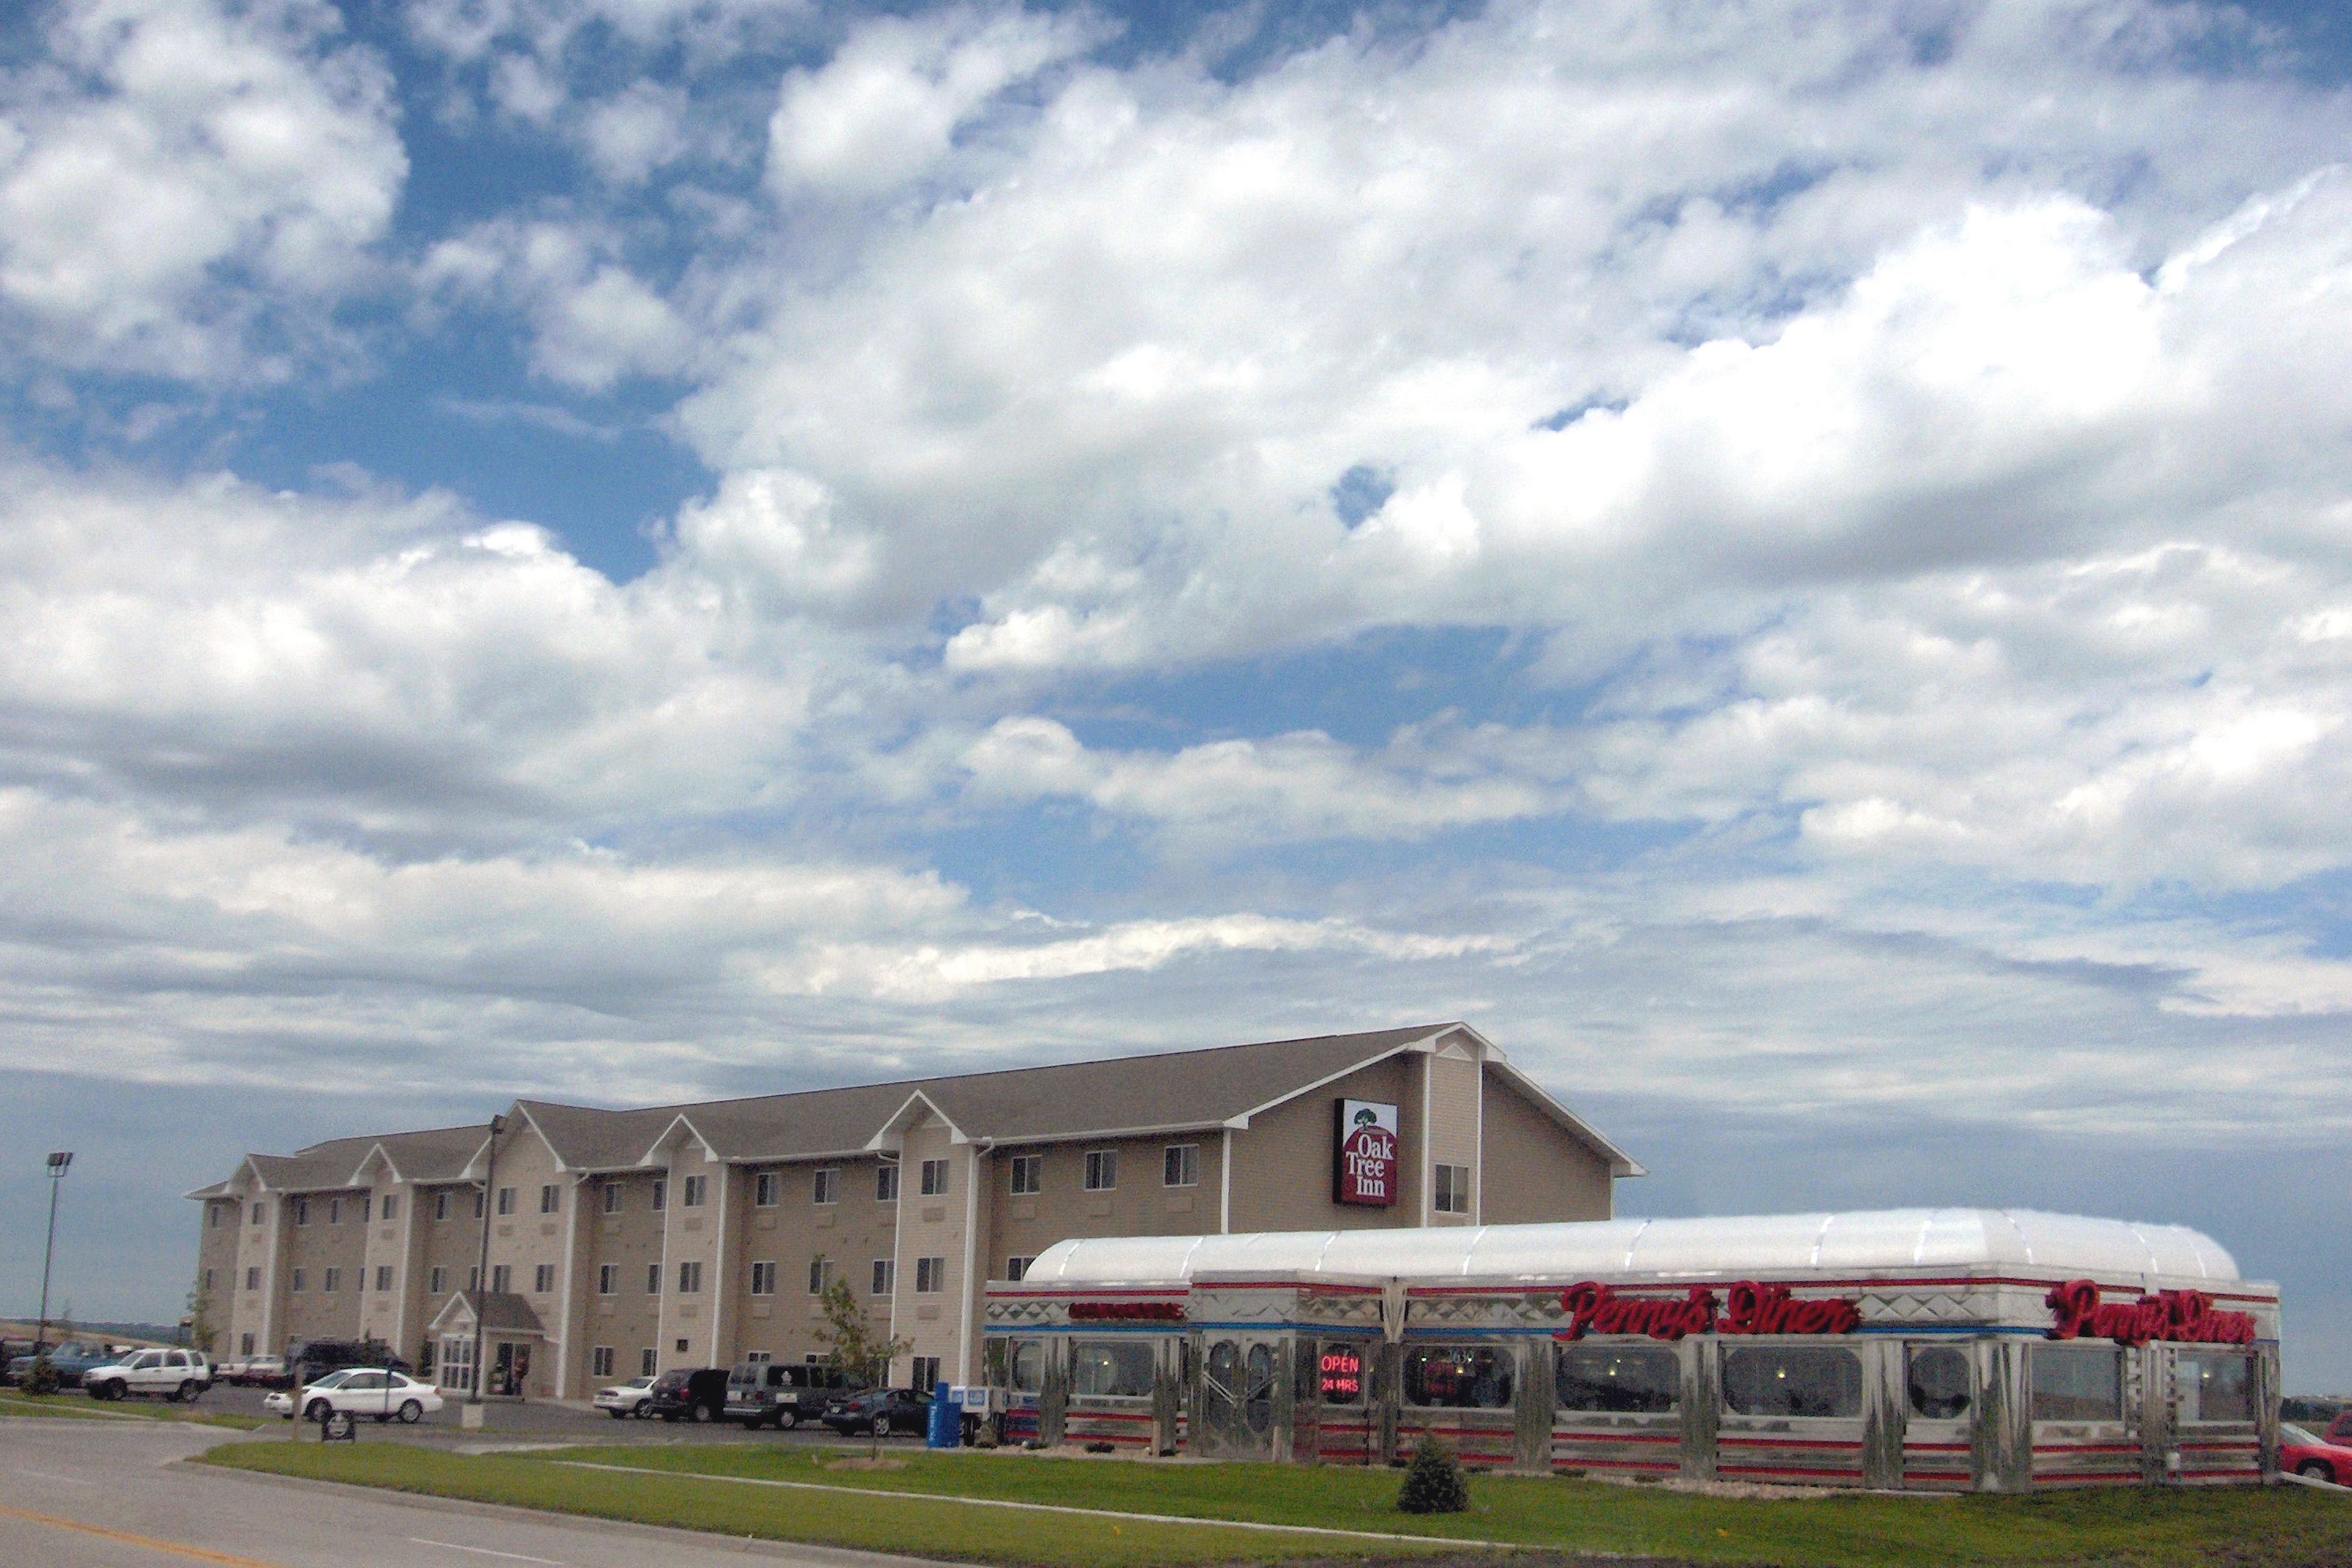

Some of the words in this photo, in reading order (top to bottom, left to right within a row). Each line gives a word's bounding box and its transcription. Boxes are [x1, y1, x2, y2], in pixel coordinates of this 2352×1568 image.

[1357, 1134, 1394, 1160] Oak
[1346, 1151, 1385, 1177] Tree
[1356, 1176, 1385, 1197] Inn
[1552, 1281, 1718, 1341] Penny's
[1716, 1280, 1860, 1333] Diner
[1321, 1355, 1359, 1373] OPEN
[1322, 1378, 1334, 1391] 24
[1336, 1379, 1359, 1392] HRS
